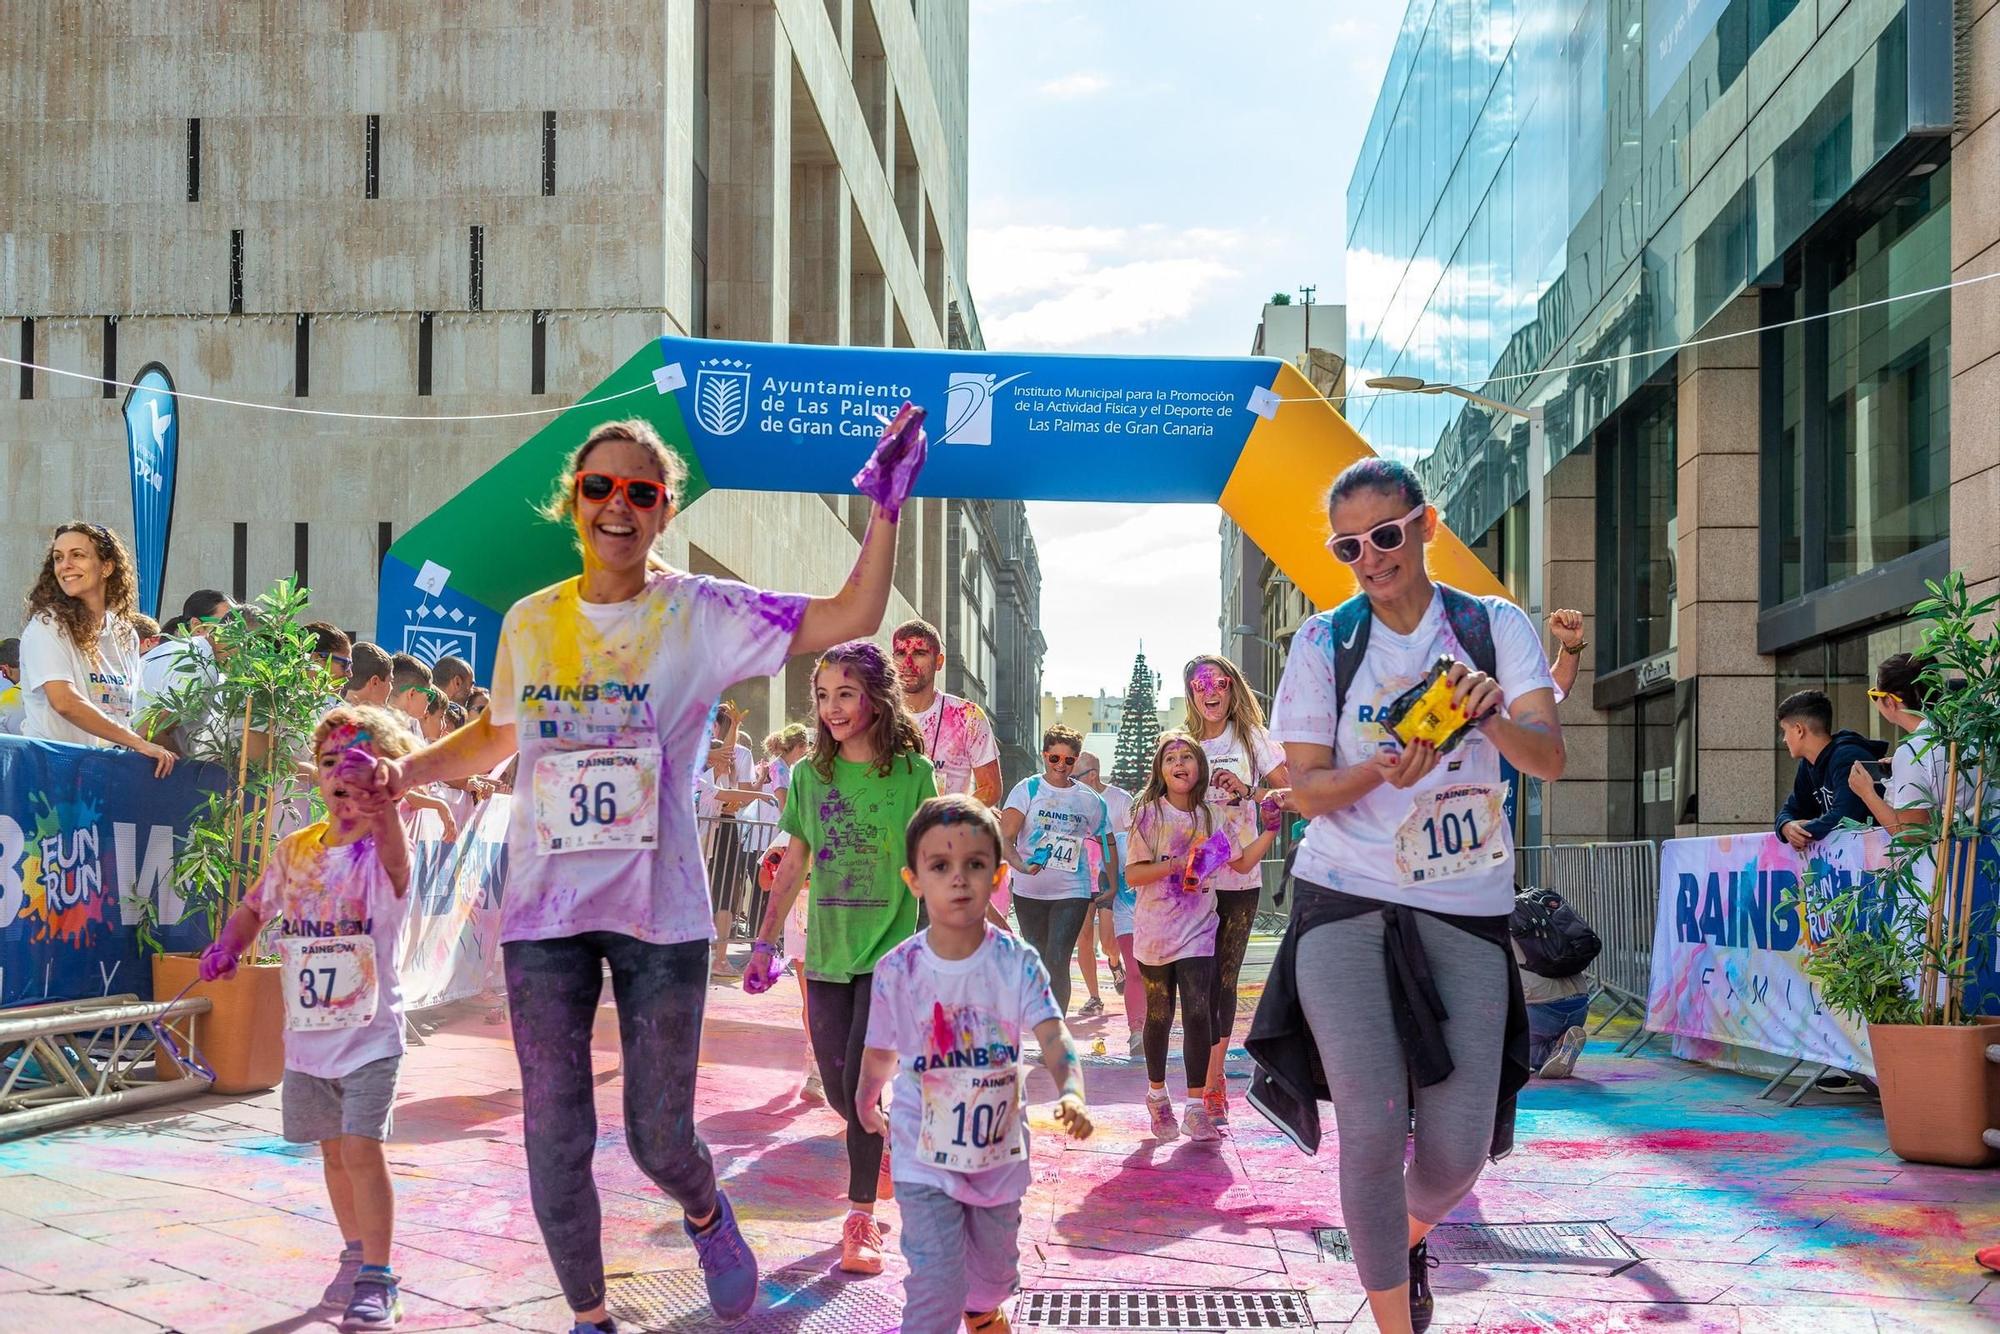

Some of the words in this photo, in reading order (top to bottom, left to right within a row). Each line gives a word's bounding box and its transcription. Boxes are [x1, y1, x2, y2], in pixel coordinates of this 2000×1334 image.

[762, 377, 911, 398] Ayuntamiento
[1014, 386, 1062, 397] Instituto
[1065, 387, 1123, 400] Municipal
[1126, 391, 1153, 401] para
[1156, 390, 1167, 400] la
[1170, 390, 1234, 401] Promoción
[761, 395, 785, 412] de
[797, 398, 829, 414] Las
[841, 399, 900, 417] Palma
[1015, 401, 1030, 411] de
[1033, 401, 1044, 412] la
[1047, 402, 1101, 413] Actividad
[1139, 406, 1147, 418] y
[1150, 404, 1161, 414] el
[1164, 405, 1213, 418] Deporte
[1217, 406, 1233, 417] de
[760, 415, 783, 432] de
[788, 418, 832, 435] Gran
[839, 420, 885, 438] Cana
[1029, 418, 1049, 431] Las
[1054, 419, 1100, 433] Palmas
[1104, 421, 1121, 434] de
[1125, 421, 1158, 435] Gran
[1162, 422, 1213, 435] Canaria
[89, 673, 127, 685] RAINB
[570, 781, 617, 826] 36
[42, 824, 100, 873] FUN
[1422, 808, 1482, 860] 101
[43, 861, 102, 911] RUN
[300, 968, 336, 1008] 37
[1702, 968, 1824, 1016] FAMIL
[952, 1100, 1007, 1149] 102
